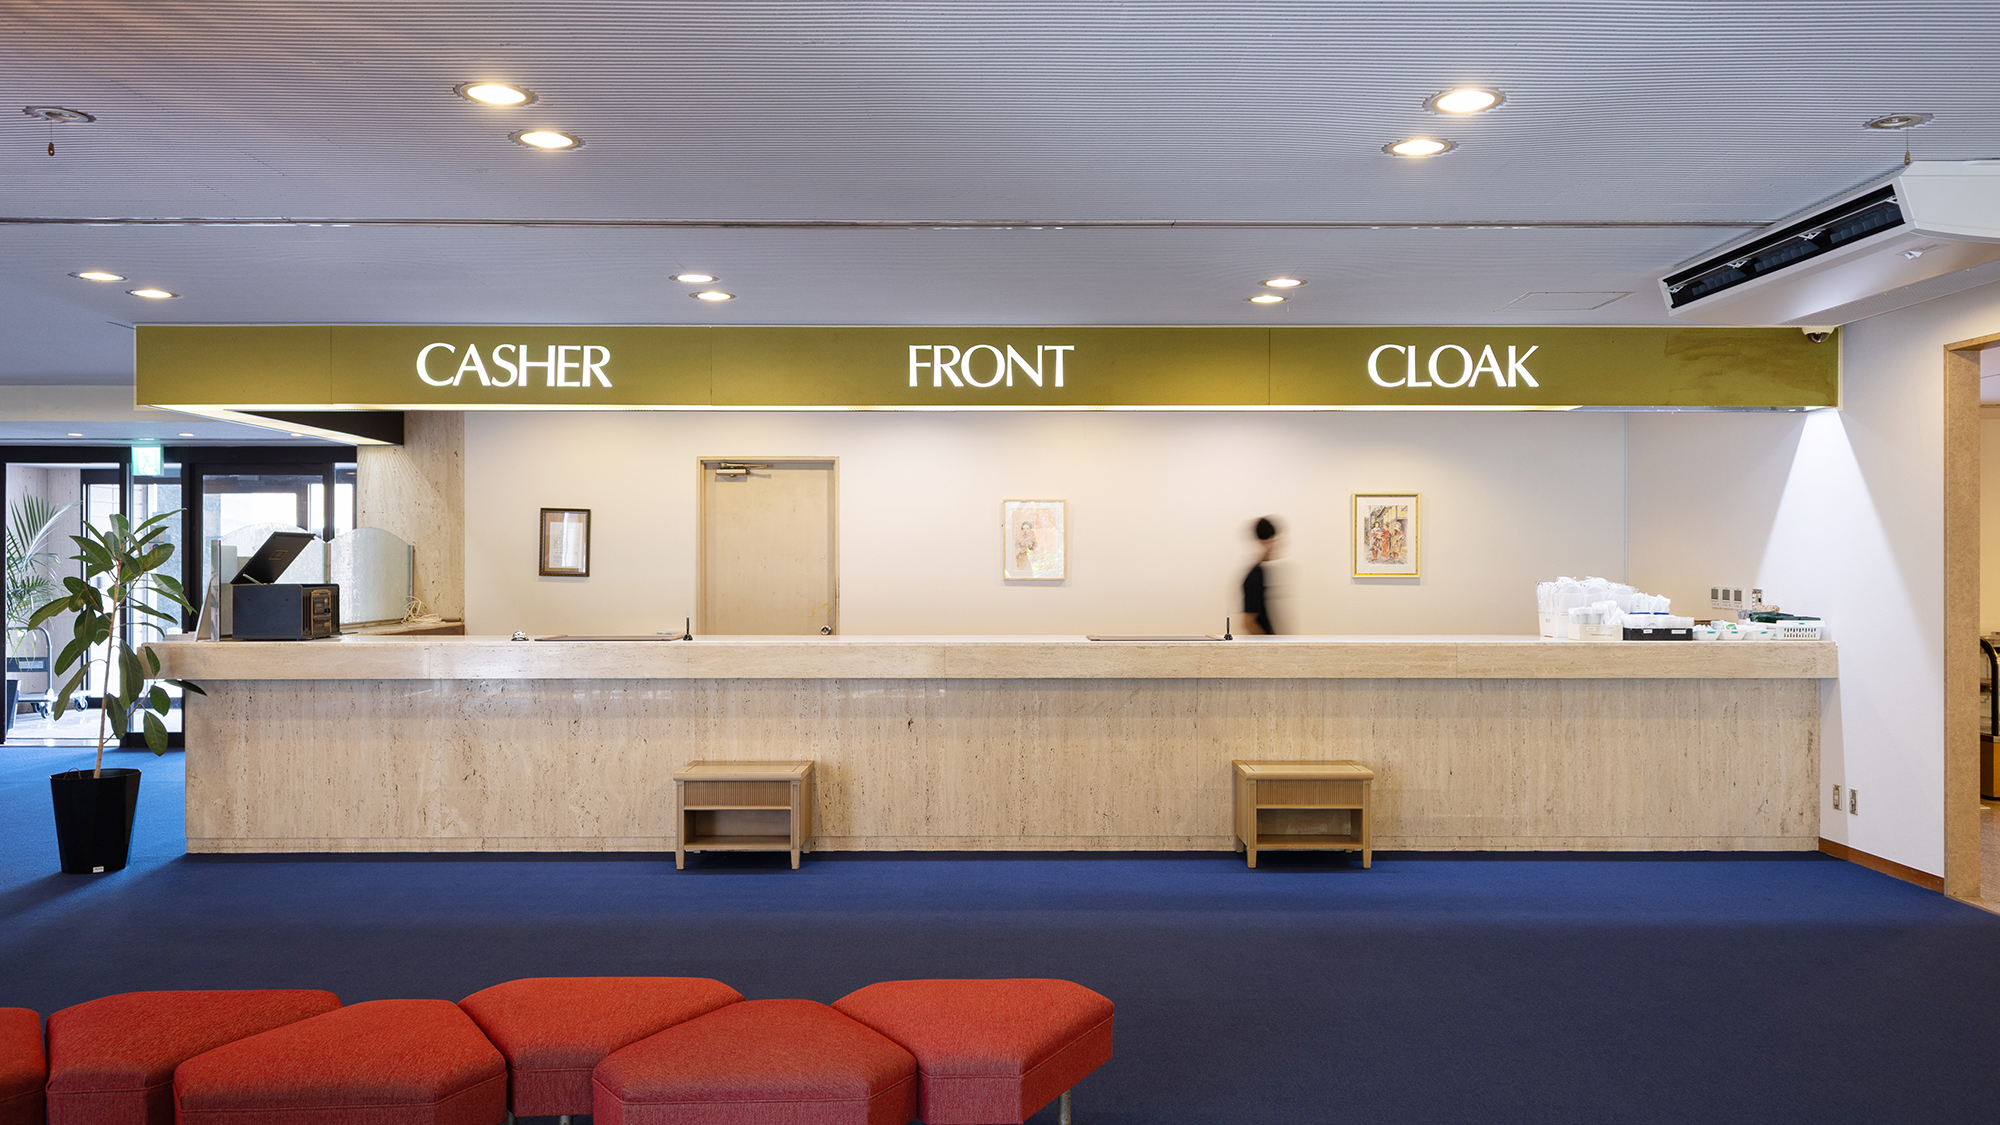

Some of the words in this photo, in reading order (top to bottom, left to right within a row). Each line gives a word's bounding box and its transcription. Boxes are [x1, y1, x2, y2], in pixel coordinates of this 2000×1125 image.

[416, 342, 613, 388] CASHER
[908, 344, 1075, 388] FRONT
[1367, 344, 1540, 388] CLOAK
